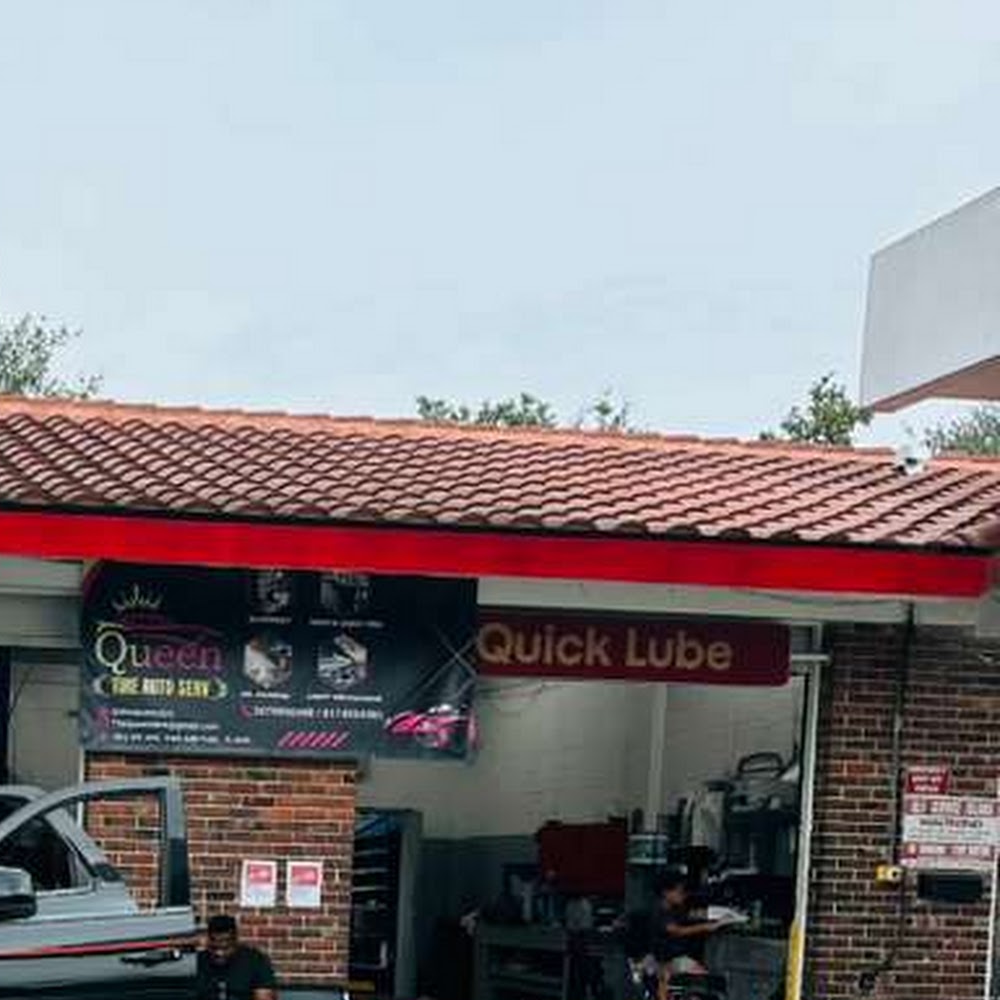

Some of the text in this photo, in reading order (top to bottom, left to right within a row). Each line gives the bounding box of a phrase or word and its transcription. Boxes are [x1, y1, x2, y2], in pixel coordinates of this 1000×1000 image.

[95, 631, 222, 674] Queen
[478, 622, 732, 670] Quick Lube
[142, 678, 174, 696] AUTO
